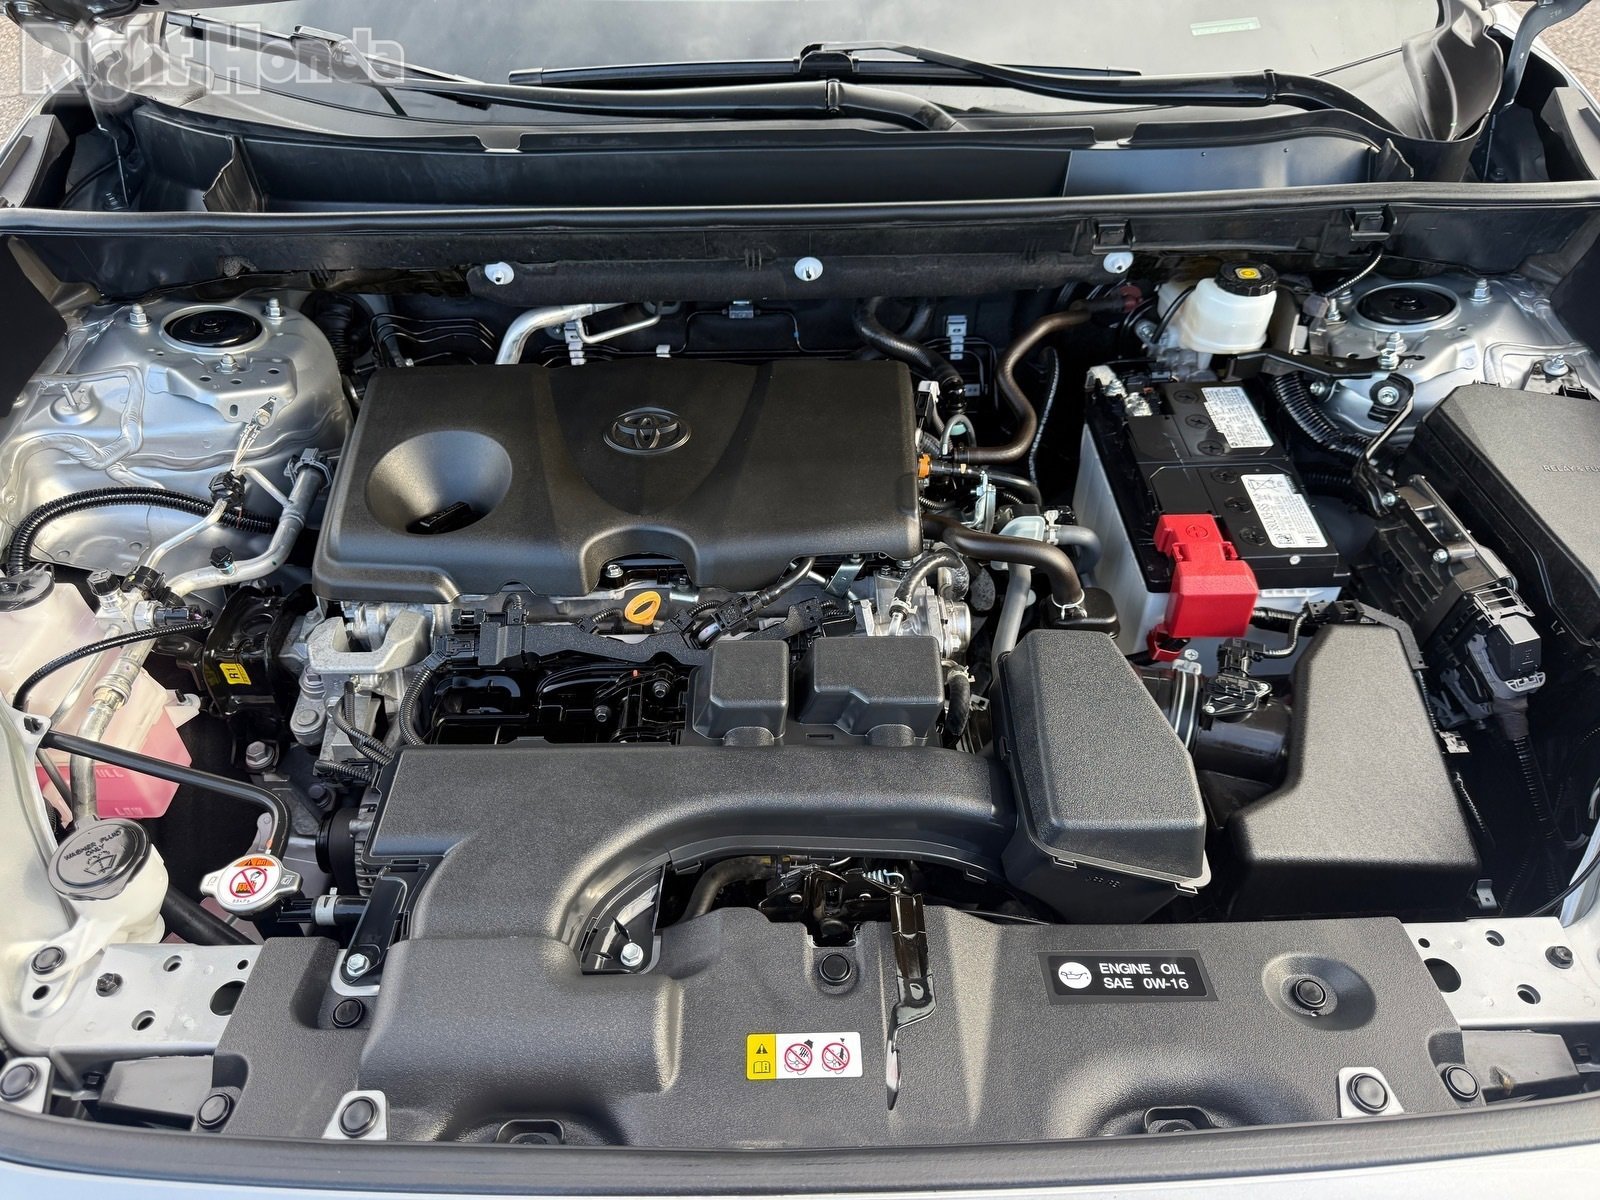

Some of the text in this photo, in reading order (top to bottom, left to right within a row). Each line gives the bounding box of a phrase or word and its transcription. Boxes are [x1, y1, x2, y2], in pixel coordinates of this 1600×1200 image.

[1099, 962, 1185, 975] ENGINE OIL
[1103, 977, 1189, 990] SAE 0W-16
